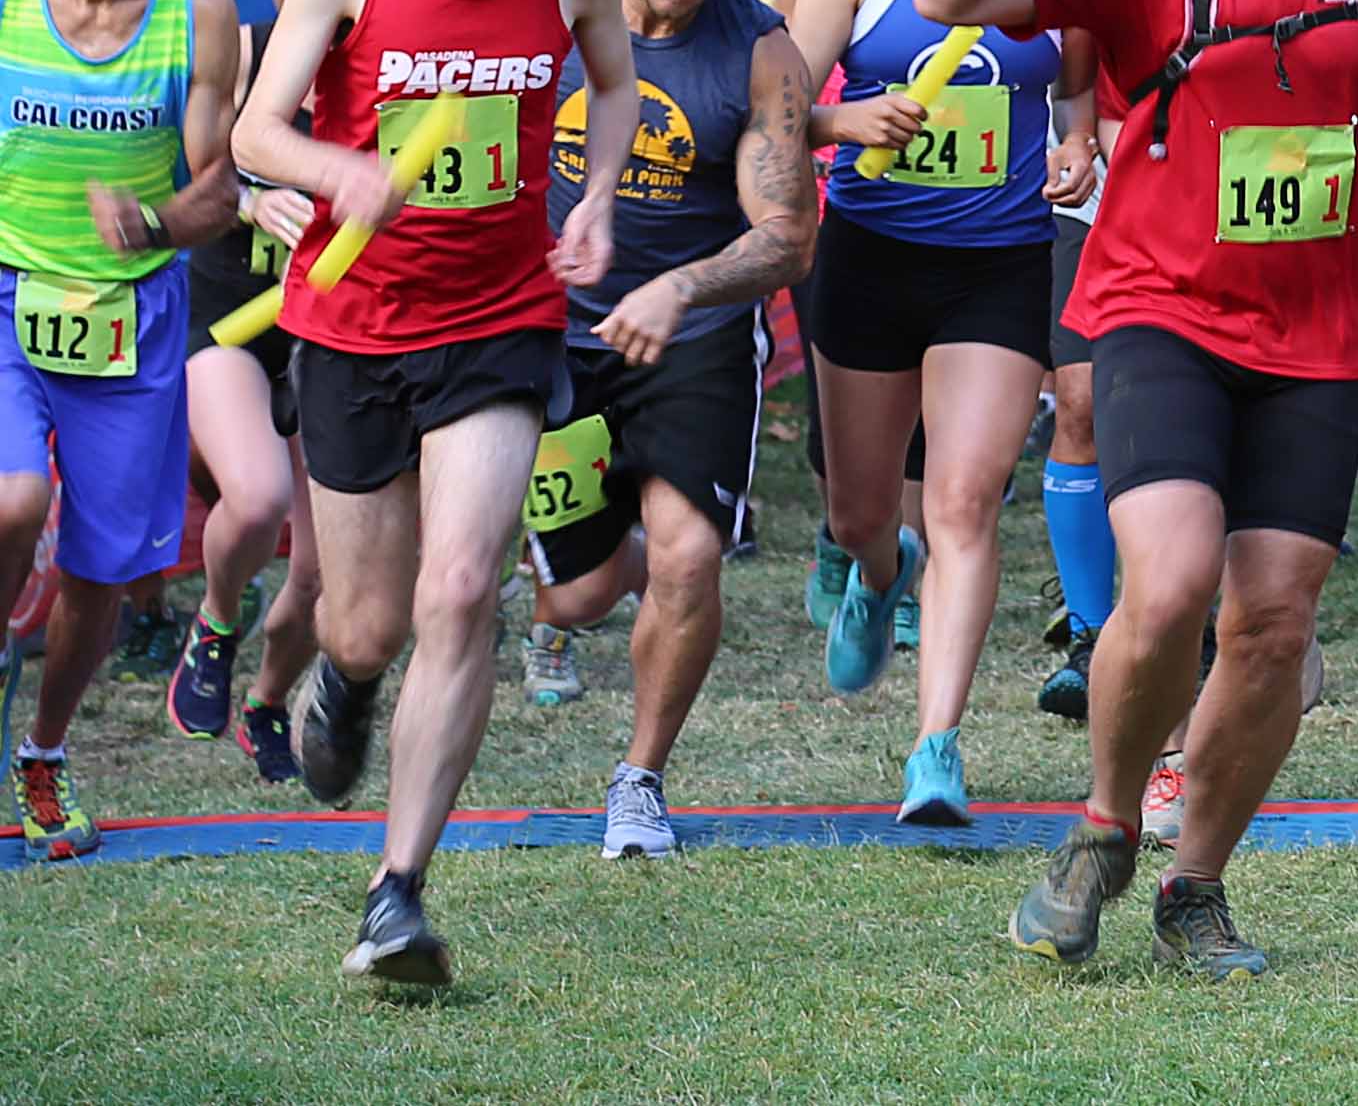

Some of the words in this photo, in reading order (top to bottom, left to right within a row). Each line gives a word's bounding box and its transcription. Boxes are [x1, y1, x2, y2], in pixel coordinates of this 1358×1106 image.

[377, 50, 553, 94] PACERS
[414, 50, 475, 62] PASADENA
[12, 96, 61, 127] CAL
[69, 104, 164, 132] COAST
[389, 146, 463, 194] 43
[486, 142, 507, 191] 1
[979, 130, 998, 174] 1
[1229, 175, 1301, 227] 149
[1321, 174, 1340, 223] 1
[24, 311, 90, 361] 112
[107, 317, 126, 363] 1
[528, 470, 582, 518] 52
